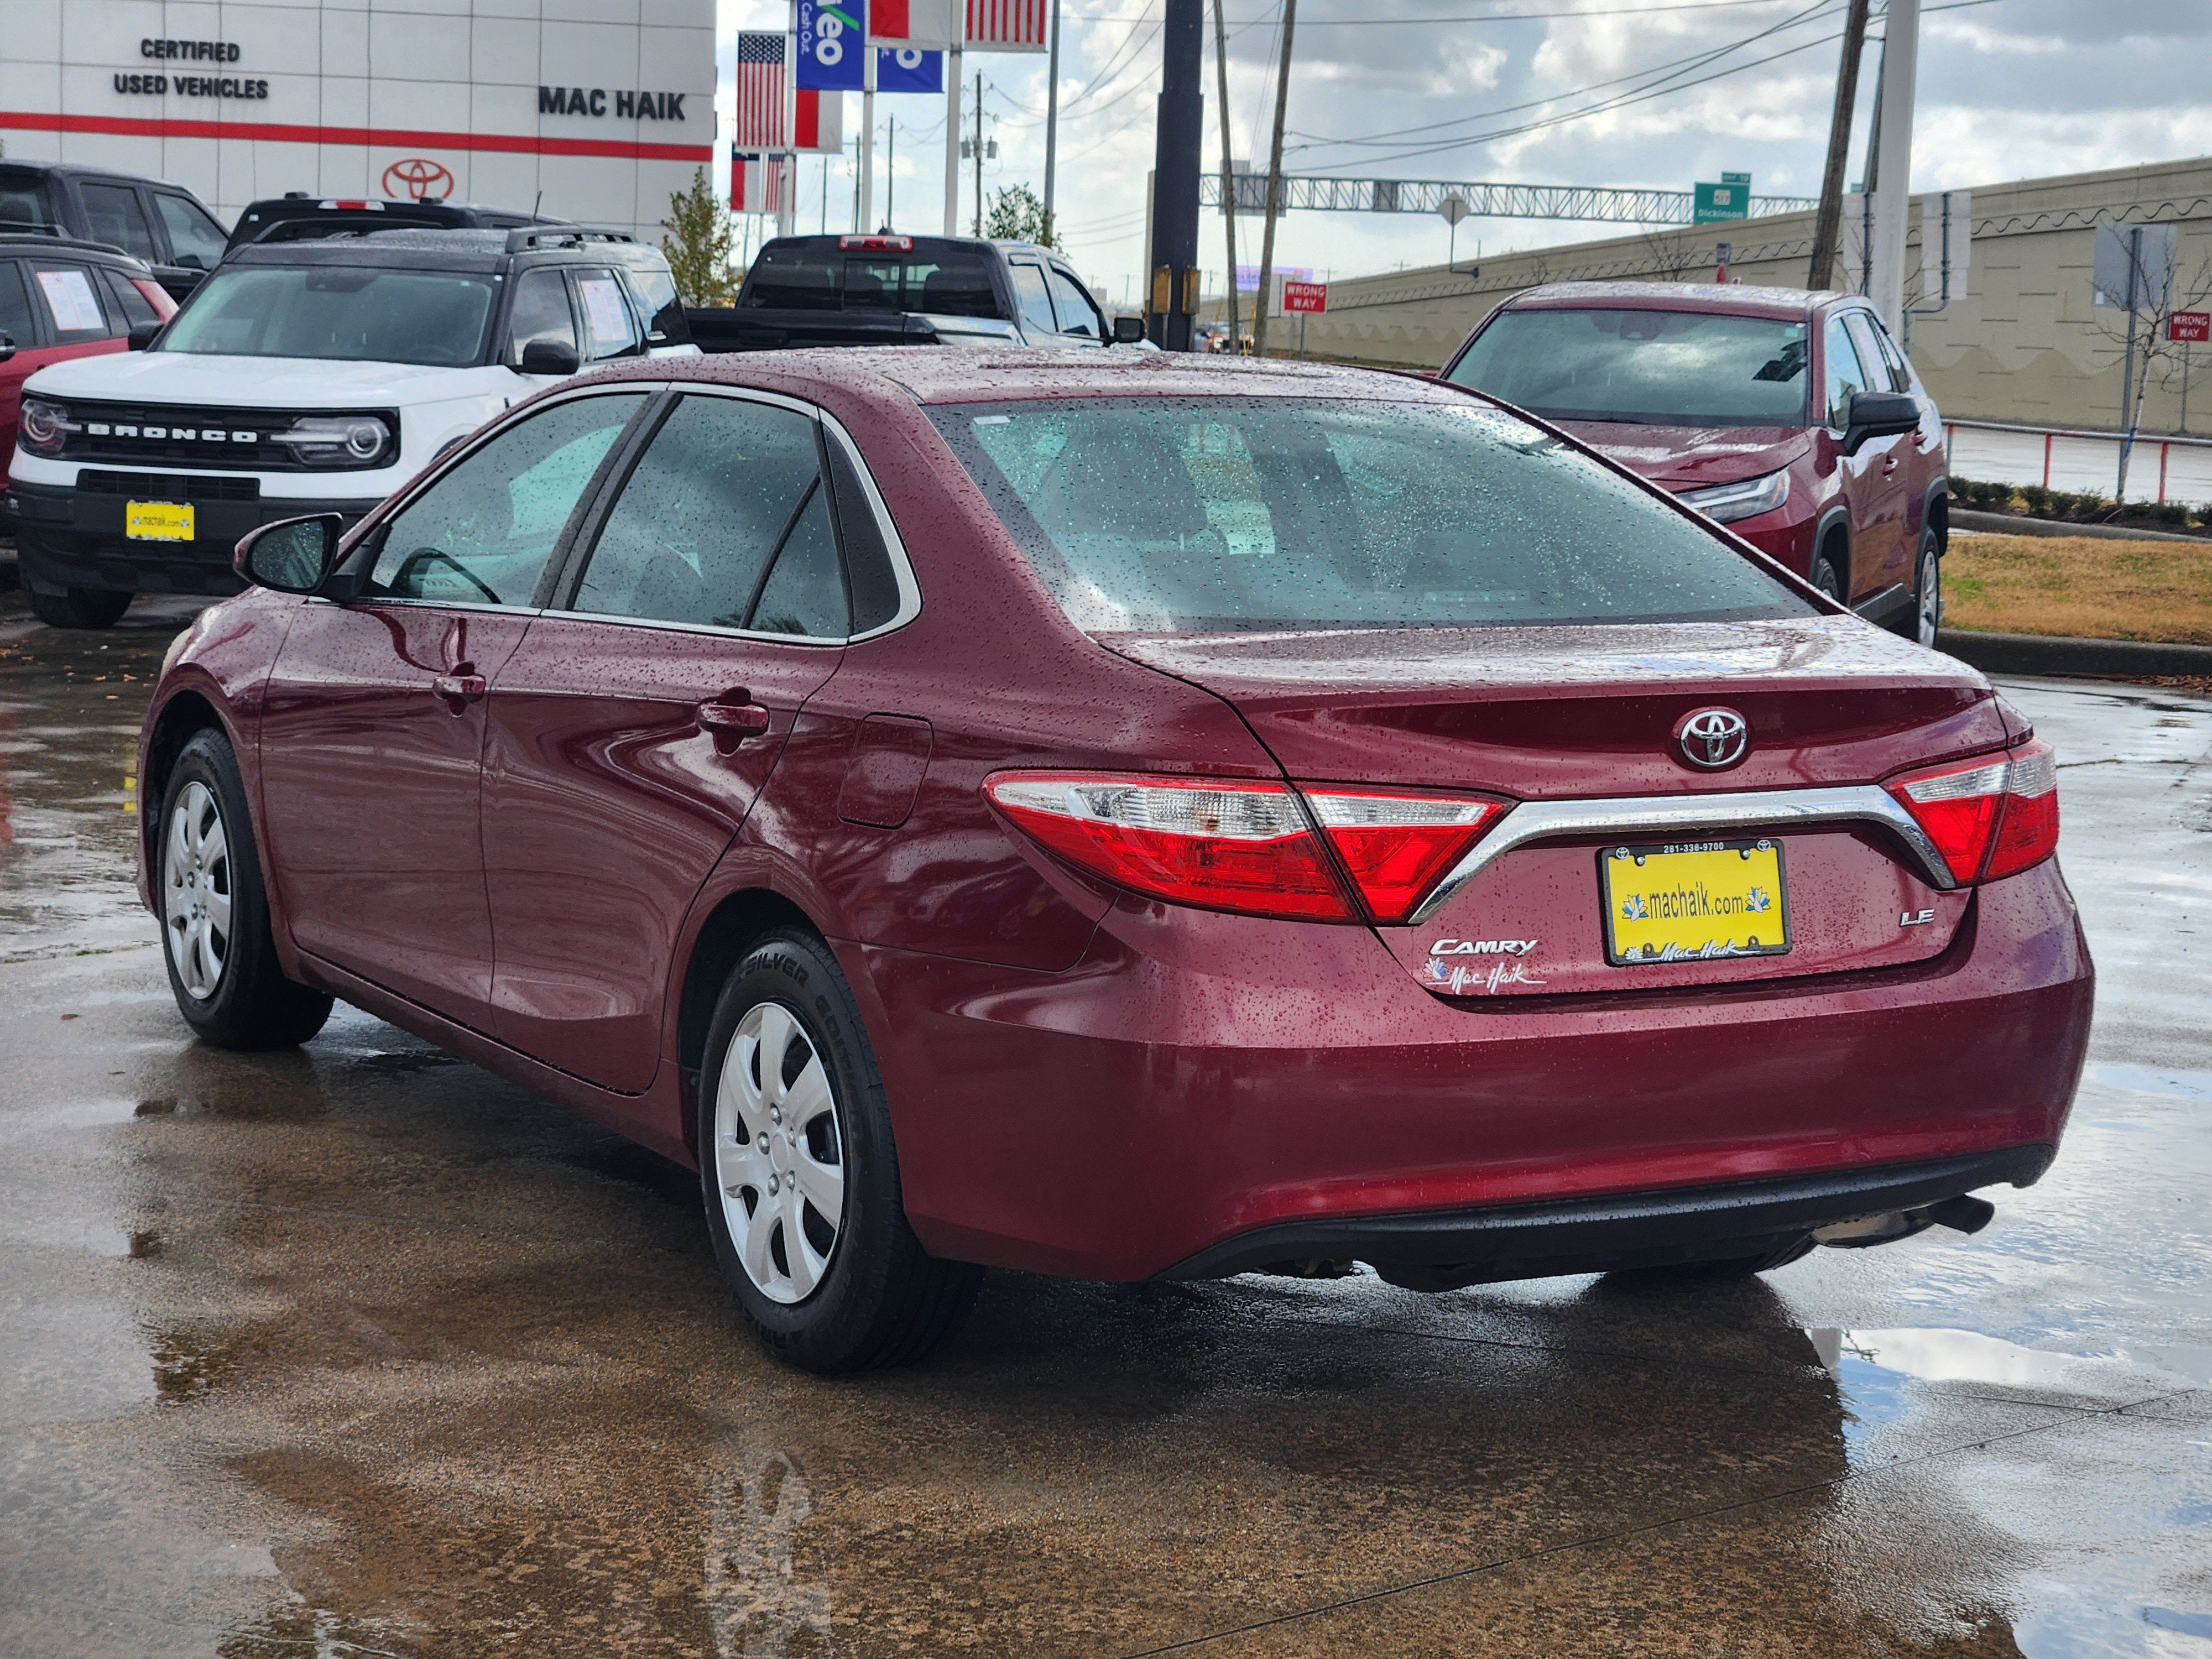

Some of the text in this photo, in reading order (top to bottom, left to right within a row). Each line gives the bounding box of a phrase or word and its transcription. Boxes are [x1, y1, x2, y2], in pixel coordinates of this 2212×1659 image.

[140, 38, 241, 61] CERTIFIED
[114, 73, 269, 99] USED VEHICLES
[539, 86, 686, 121] MAC HAIK
[1697, 208, 1745, 218] Dickinson
[1287, 284, 1326, 297] WRONG
[1293, 298, 1317, 309] WAY
[2173, 315, 2208, 326] WRONG
[2179, 327, 2200, 338] WAY
[87, 423, 258, 443] BRONCO
[1663, 842, 1724, 854] 281-338-9700
[1649, 881, 1744, 920] machaik.com
[1900, 909, 1936, 926] LE
[1429, 938, 1539, 957] CAMRY
[1658, 938, 1749, 962] Mac Haik
[744, 952, 809, 988] SILVER
[1446, 962, 1534, 994] Mac Haik
